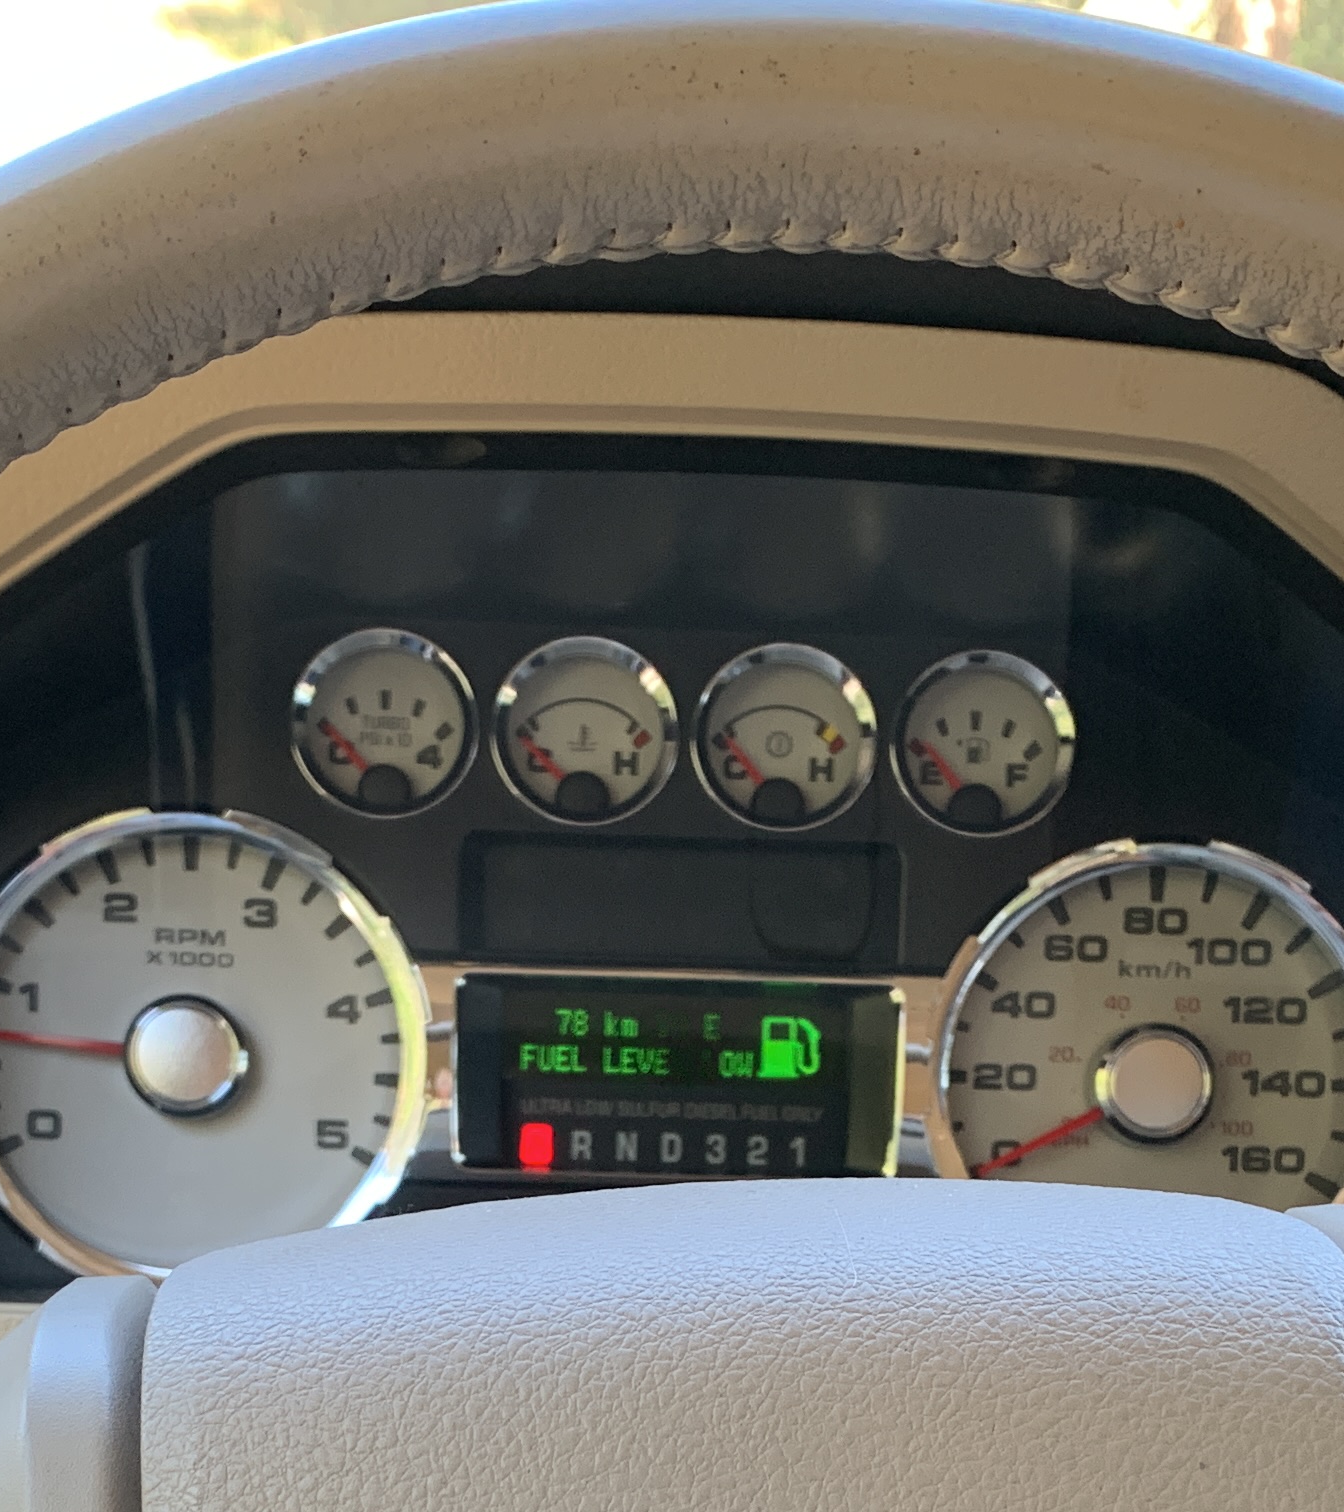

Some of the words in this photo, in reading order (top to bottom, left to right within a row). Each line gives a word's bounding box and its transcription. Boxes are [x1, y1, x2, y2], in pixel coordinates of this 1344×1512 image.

[417, 745, 443, 769] 4
[614, 751, 639, 776] H
[809, 757, 834, 782] H
[920, 760, 944, 785] E
[1007, 763, 1029, 787] F
[102, 892, 138, 923] 2
[243, 898, 278, 928] 3
[1123, 907, 1189, 936] 80
[154, 928, 227, 947] RPM
[1044, 935, 1109, 963] 60
[1186, 938, 1273, 966] 100
[1118, 959, 1192, 981] km/h
[18, 983, 41, 1012] 1
[326, 995, 361, 1025] 4
[991, 991, 1056, 1020] 40
[1104, 996, 1131, 1012] 40
[1222, 997, 1308, 1026] 120
[555, 1008, 589, 1037] 78
[603, 1010, 639, 1038] km
[519, 1043, 588, 1073] FUEL
[602, 1046, 671, 1076] LEVE
[1049, 1046, 1075, 1064] 20
[972, 1063, 1037, 1092] 20
[1241, 1069, 1327, 1098] 140
[27, 1109, 63, 1140] 0
[316, 1119, 350, 1150] 5
[570, 1129, 593, 1161] R
[615, 1130, 638, 1162] N
[660, 1131, 684, 1164] D
[705, 1133, 727, 1165] 3
[746, 1134, 770, 1166] 2
[788, 1135, 805, 1168] 1
[1221, 1147, 1306, 1175] 160
